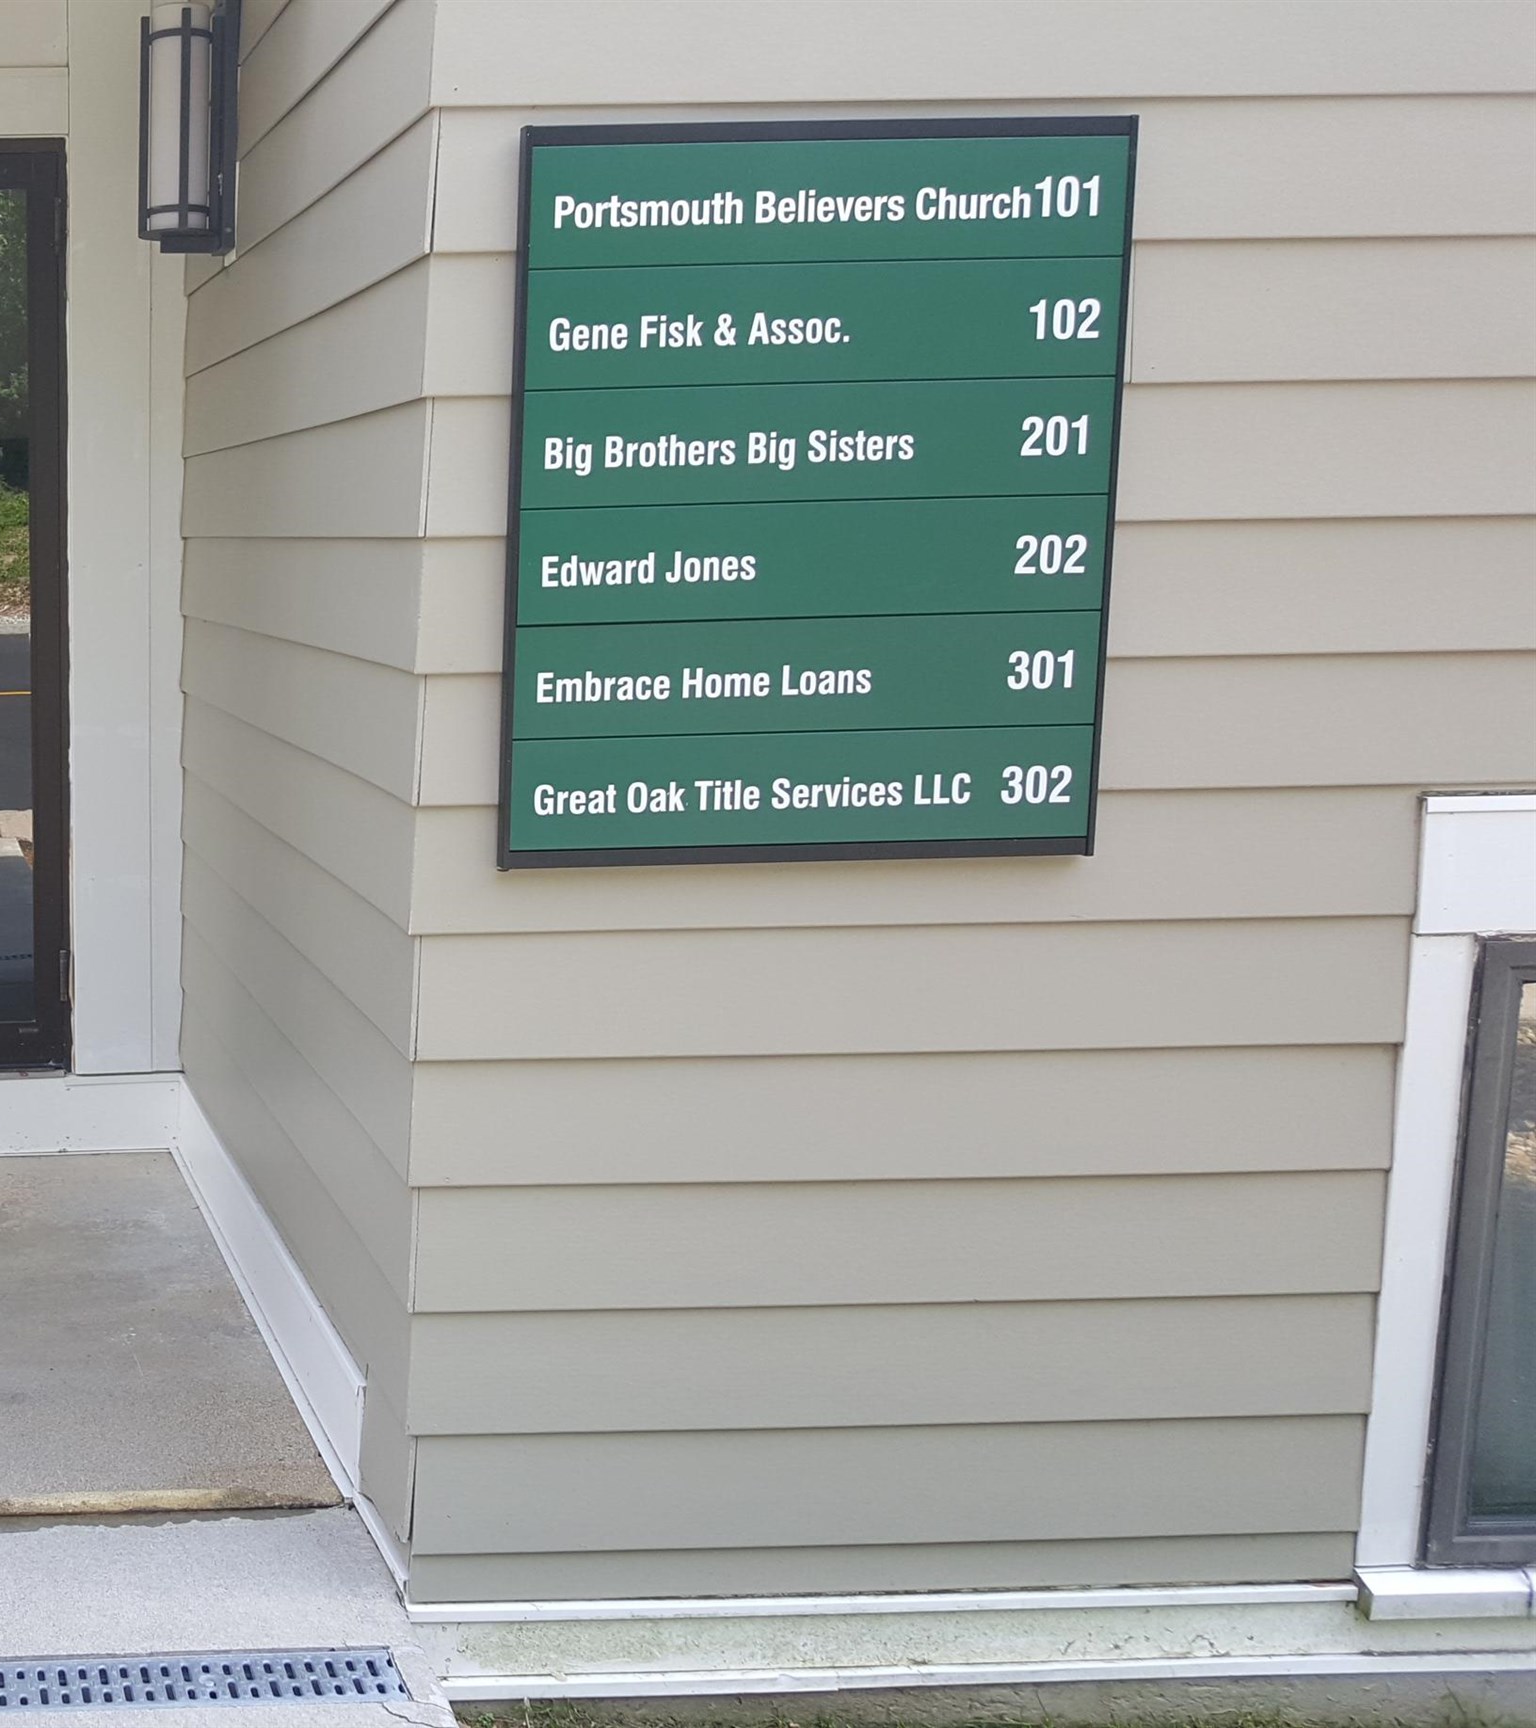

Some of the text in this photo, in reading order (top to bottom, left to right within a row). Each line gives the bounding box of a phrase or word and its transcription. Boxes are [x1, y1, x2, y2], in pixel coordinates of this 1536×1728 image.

[554, 175, 1101, 229] Portsmouth Believers Church 101
[549, 312, 851, 352] Gene Fisk & Assoc.
[1029, 297, 1101, 340] 102
[544, 429, 914, 477] Big Brothers Big Sisters
[1020, 414, 1090, 457] 201
[541, 550, 756, 588] Edward Jones
[1014, 534, 1088, 575] 202
[536, 664, 872, 703] Embrace Home Loans
[1007, 649, 1075, 690] 301
[533, 772, 972, 816] Great Oak Title Services LLC
[1000, 764, 1073, 805] 302
